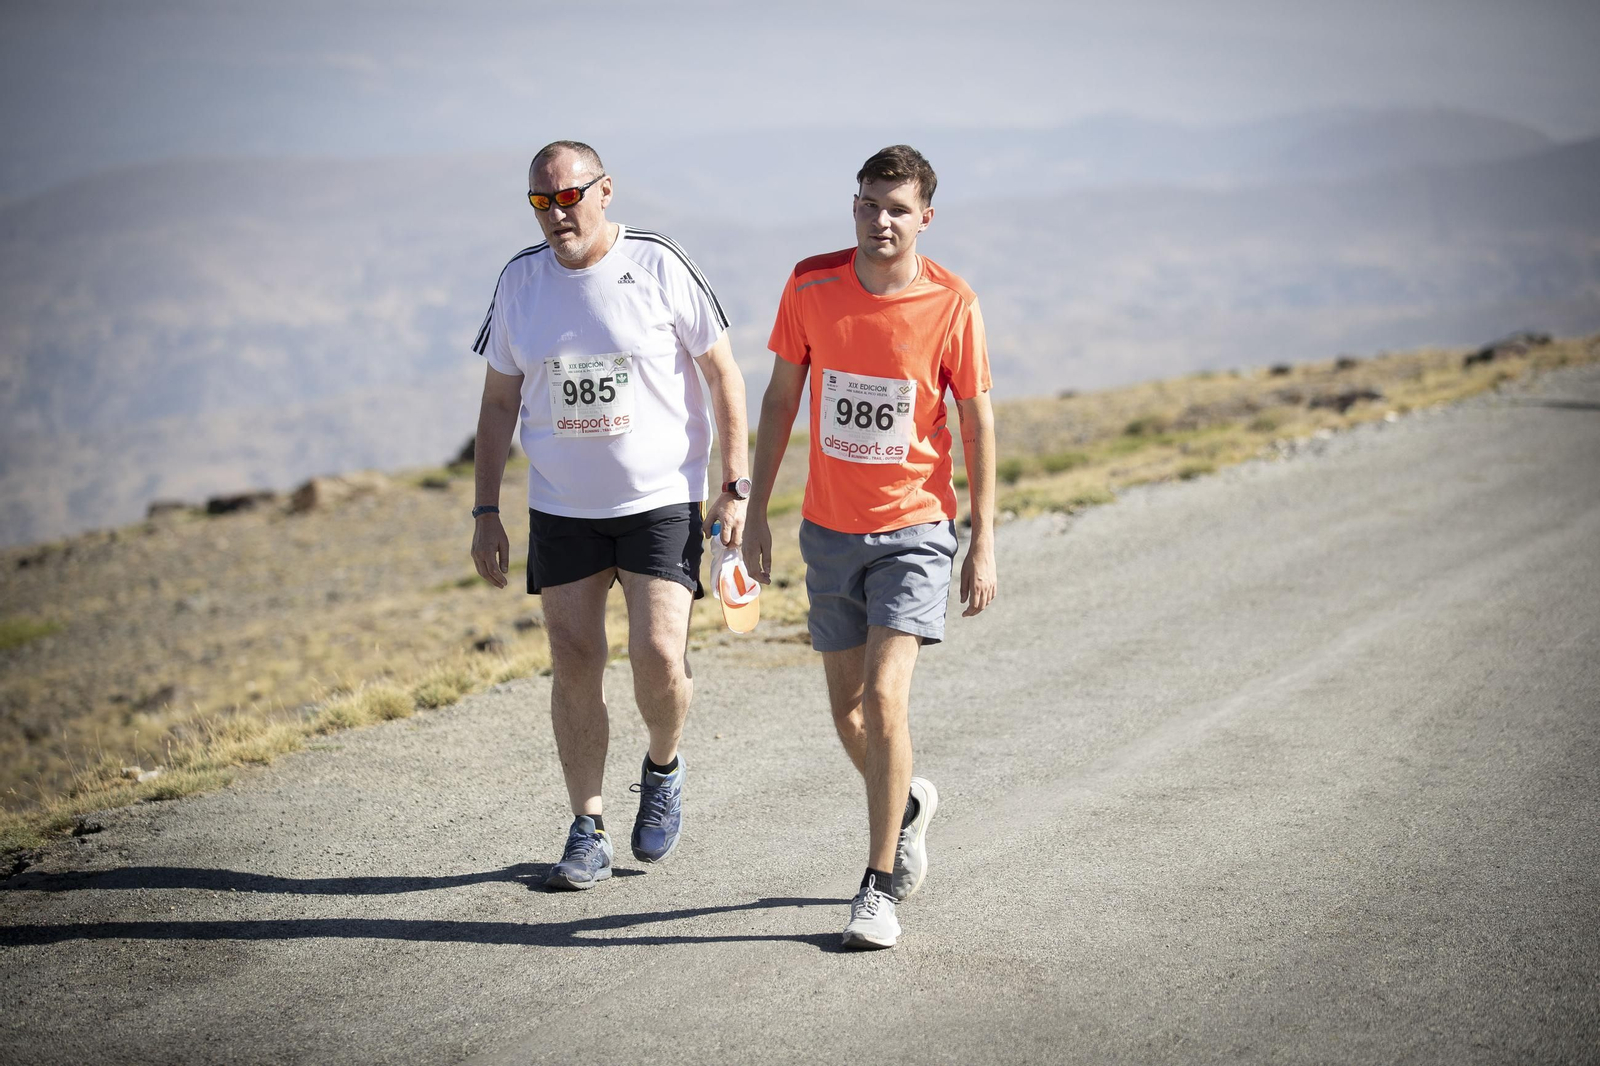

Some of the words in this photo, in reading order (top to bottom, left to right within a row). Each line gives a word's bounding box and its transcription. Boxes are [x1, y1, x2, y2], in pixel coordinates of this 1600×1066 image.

[563, 377, 616, 405] 985
[848, 381, 859, 389] XIX
[557, 414, 630, 433] alssport.es
[836, 398, 894, 431] 986
[824, 434, 904, 457] alssport.es
